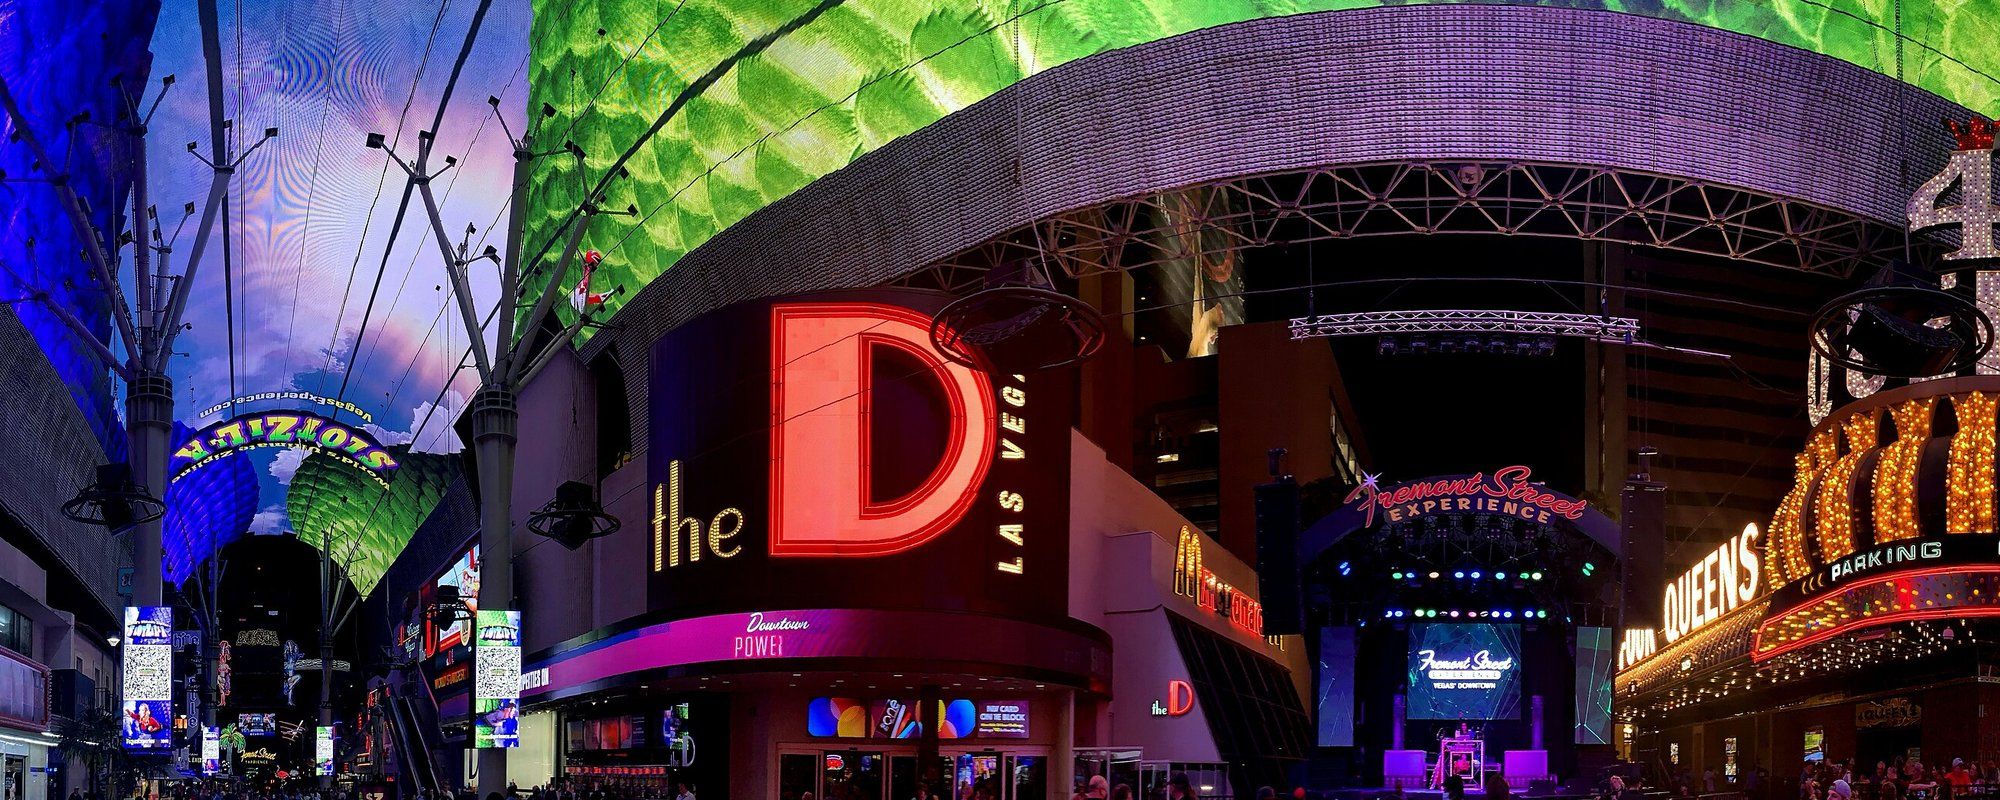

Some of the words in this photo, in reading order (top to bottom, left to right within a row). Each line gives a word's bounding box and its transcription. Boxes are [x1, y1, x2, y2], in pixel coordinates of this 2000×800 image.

[199, 392, 372, 423] VegasExperience.com
[1001, 374, 1026, 459] VEG
[652, 460, 743, 572] the
[768, 303, 997, 558] D
[327, 450, 391, 491] World's
[1343, 472, 1482, 528] Fremont
[1483, 465, 1587, 519] Street
[1389, 498, 1551, 523] EXPERIENCE
[998, 491, 1025, 574] LAS
[1831, 541, 1942, 581] PARKING
[1664, 522, 1759, 642] QUEENS
[747, 612, 809, 632] Downtown
[1419, 650, 1470, 670] Fremont
[1471, 650, 1512, 670] Street
[1152, 700, 1167, 715] the
[1168, 680, 1194, 716] D
